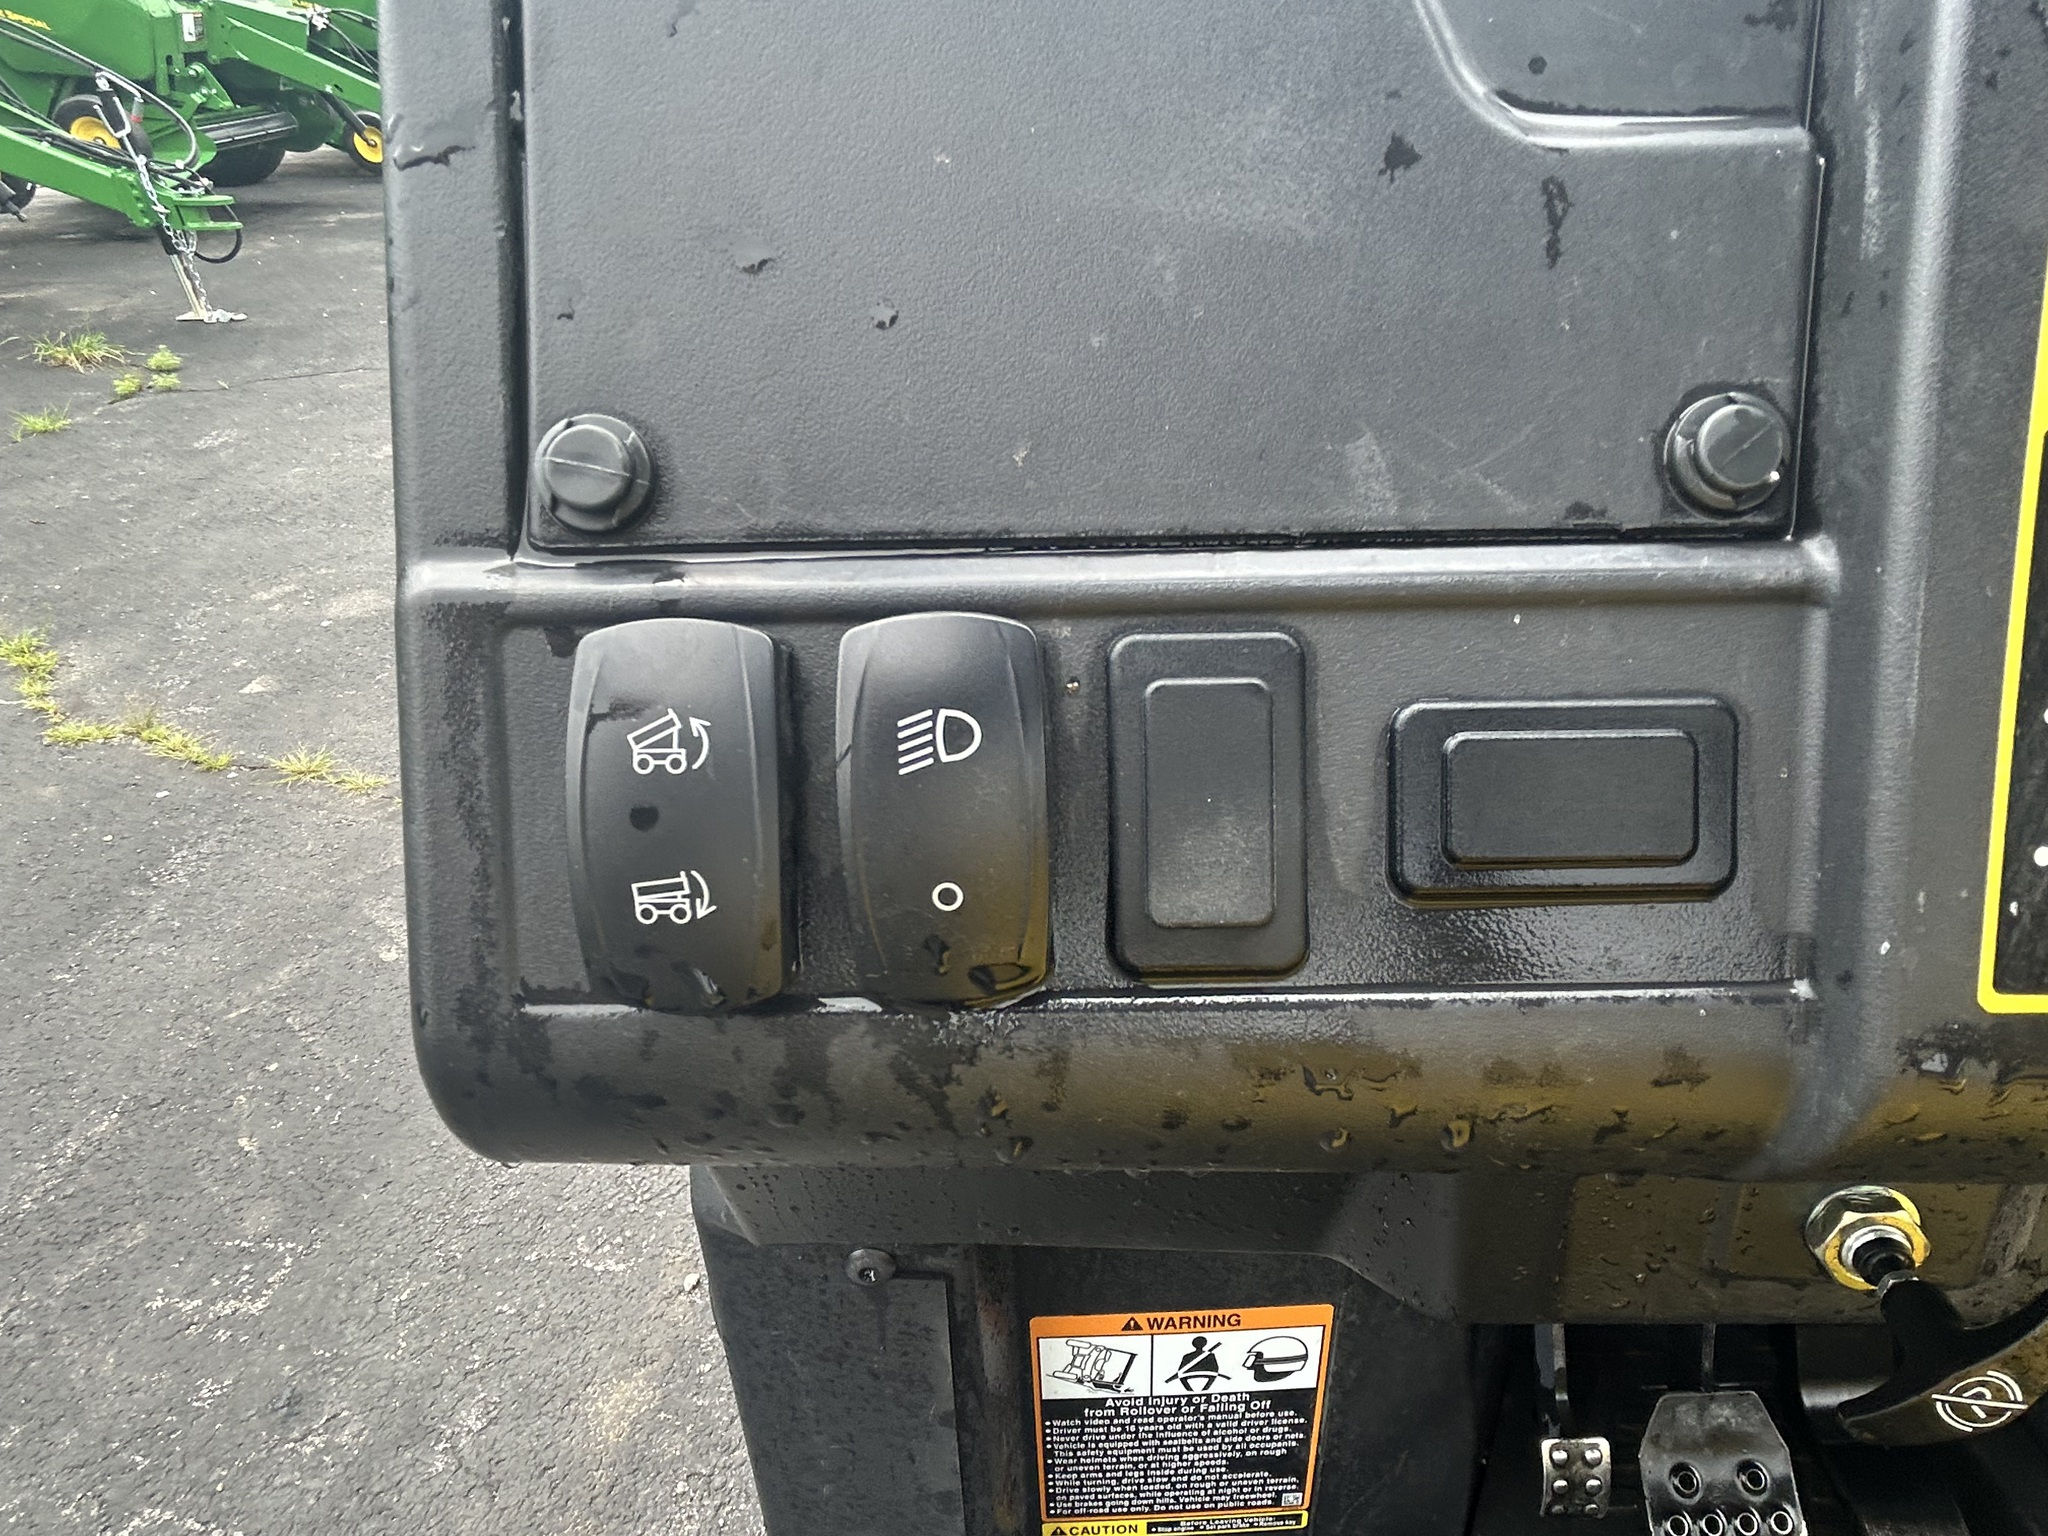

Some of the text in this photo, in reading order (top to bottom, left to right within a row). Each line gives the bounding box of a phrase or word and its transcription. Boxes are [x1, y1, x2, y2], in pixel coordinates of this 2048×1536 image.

[1147, 1314, 1241, 1330] WARNING
[1105, 1397, 1143, 1407] Avoid
[1148, 1395, 1187, 1407] Injury
[1211, 1392, 1249, 1402] Death
[1084, 1407, 1114, 1416] from
[1120, 1404, 1176, 1415] Rollover
[1200, 1402, 1245, 1413] Falling
[1250, 1401, 1270, 1410] Off
[1157, 1414, 1204, 1423] operator's
[1098, 1440, 1138, 1449] equipped
[1076, 1448, 1104, 1457] safety
[1106, 1446, 1154, 1455] equipment
[1146, 1452, 1179, 1461] driving
[1182, 1450, 1242, 1460] aggressively,
[1259, 1448, 1286, 1456] rough
[1162, 1460, 1191, 1469] higher
[1055, 1472, 1077, 1480] Keep
[1125, 1469, 1144, 1477] legs
[1177, 1466, 1207, 1475] during
[1082, 1485, 1111, 1494] slowly
[1190, 1480, 1216, 1489] rough
[1069, 1493, 1094, 1502] paved
[1164, 1488, 1205, 1497] operating
[1218, 1486, 1240, 1495] night
[1105, 1499, 1129, 1507] going
[1217, 1500, 1244, 1509] public
[1069, 1524, 1137, 1535] CAUTION
